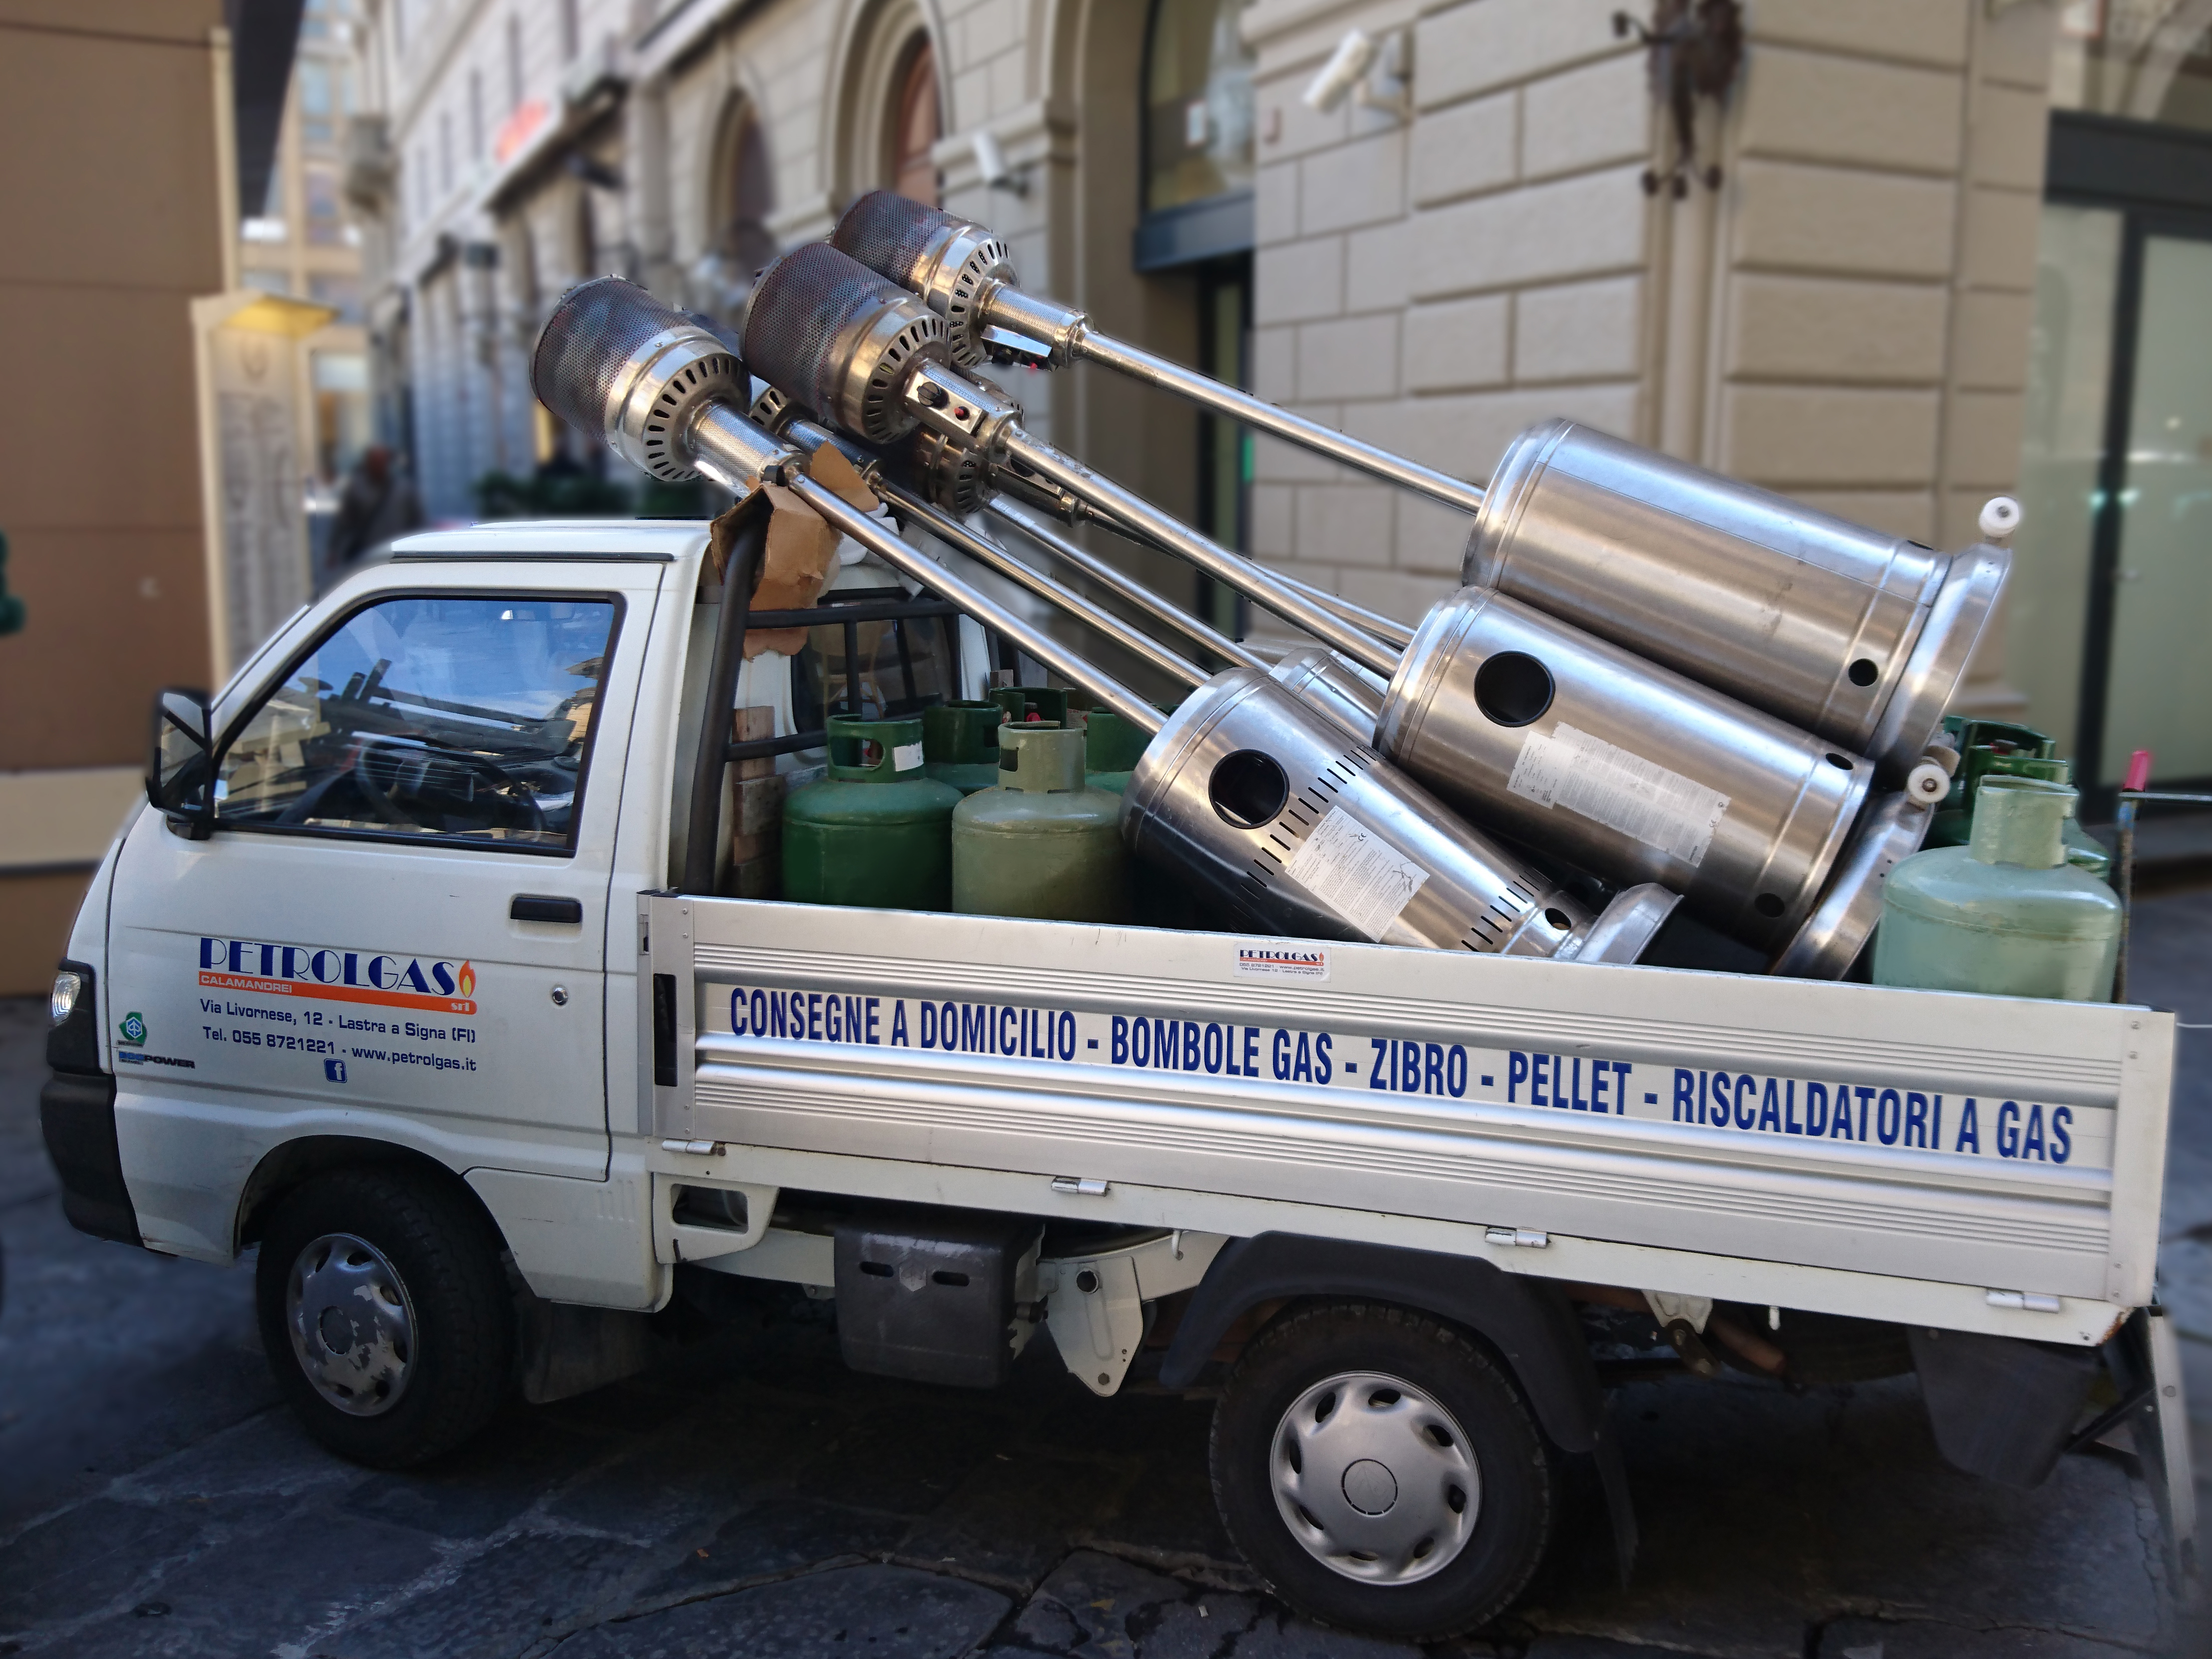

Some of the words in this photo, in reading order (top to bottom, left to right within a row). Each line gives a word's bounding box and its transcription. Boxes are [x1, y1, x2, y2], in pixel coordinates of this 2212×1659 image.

[200, 937, 456, 995] PETROLGAS
[1240, 949, 1318, 961] PETROLGAS
[201, 975, 292, 993] CALAMANDREI
[451, 1002, 470, 1011] srl
[200, 998, 221, 1014] Via
[226, 1001, 297, 1026] Livornese,
[303, 1011, 323, 1026] 12
[338, 1015, 386, 1033] Lastra
[391, 1024, 400, 1034] a
[405, 1022, 446, 1041] Signa
[452, 1027, 476, 1043] (FI)
[202, 1026, 227, 1042] Tel.
[232, 1029, 261, 1045] 055
[266, 1033, 335, 1054] 8721221
[351, 1047, 477, 1071] www.petrolgas.it
[731, 989, 880, 1045] CONSEGNE
[892, 1001, 909, 1047] A
[921, 1002, 1076, 1061] DOMICILIO
[1111, 1016, 1260, 1077] BOMBOLE
[1272, 1028, 1333, 1085] GAS
[1370, 1038, 1467, 1098] ZIBRO
[1508, 1051, 1632, 1115] PELLET
[1673, 1069, 1942, 1150] RISCALDATORI
[1956, 1098, 1980, 1154] A
[1997, 1101, 2073, 1164] GAS
